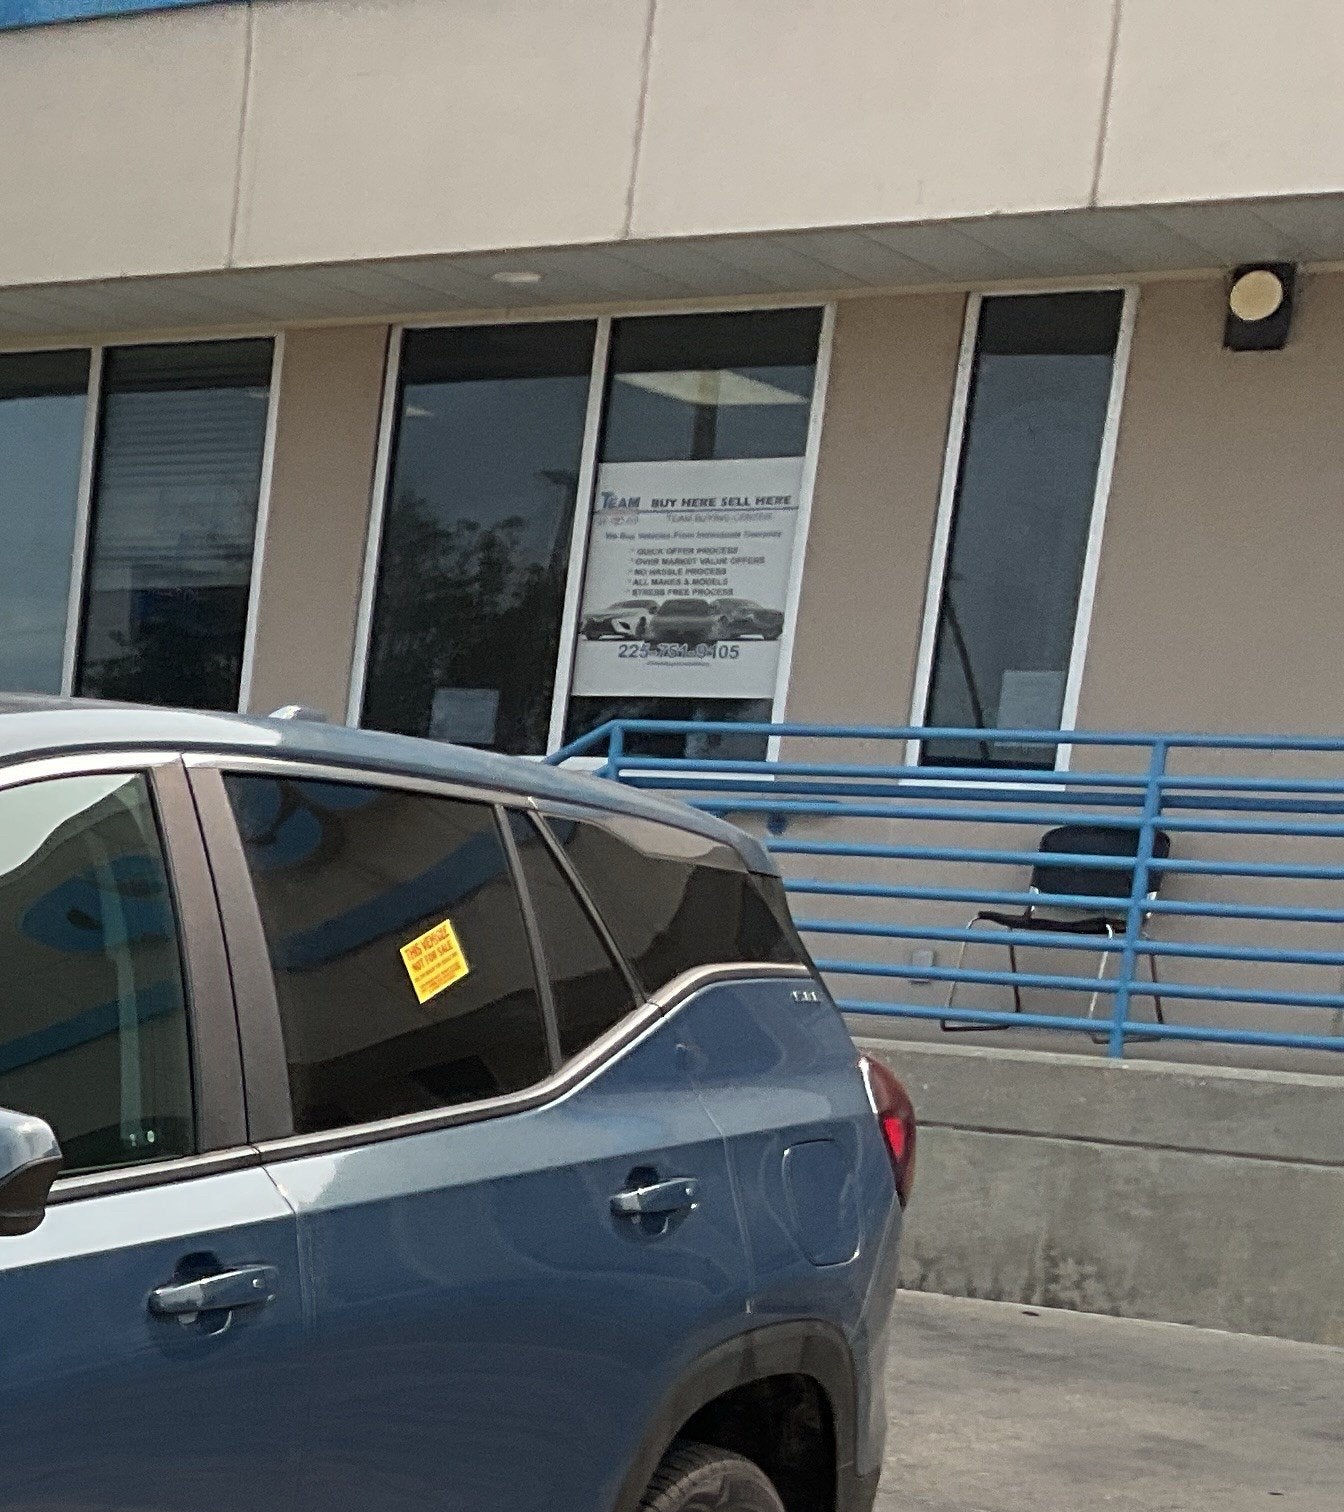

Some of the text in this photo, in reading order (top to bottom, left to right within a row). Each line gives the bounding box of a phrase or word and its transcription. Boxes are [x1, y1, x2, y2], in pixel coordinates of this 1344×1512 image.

[601, 491, 640, 509] TEAM
[651, 495, 792, 508] BUY HERE SELL HERE
[634, 568, 648, 576] NO
[632, 578, 649, 586] ALL
[651, 578, 681, 586] MAKES
[692, 578, 729, 586] MODELS
[667, 588, 690, 596] FREE
[692, 588, 733, 596] PROCESS
